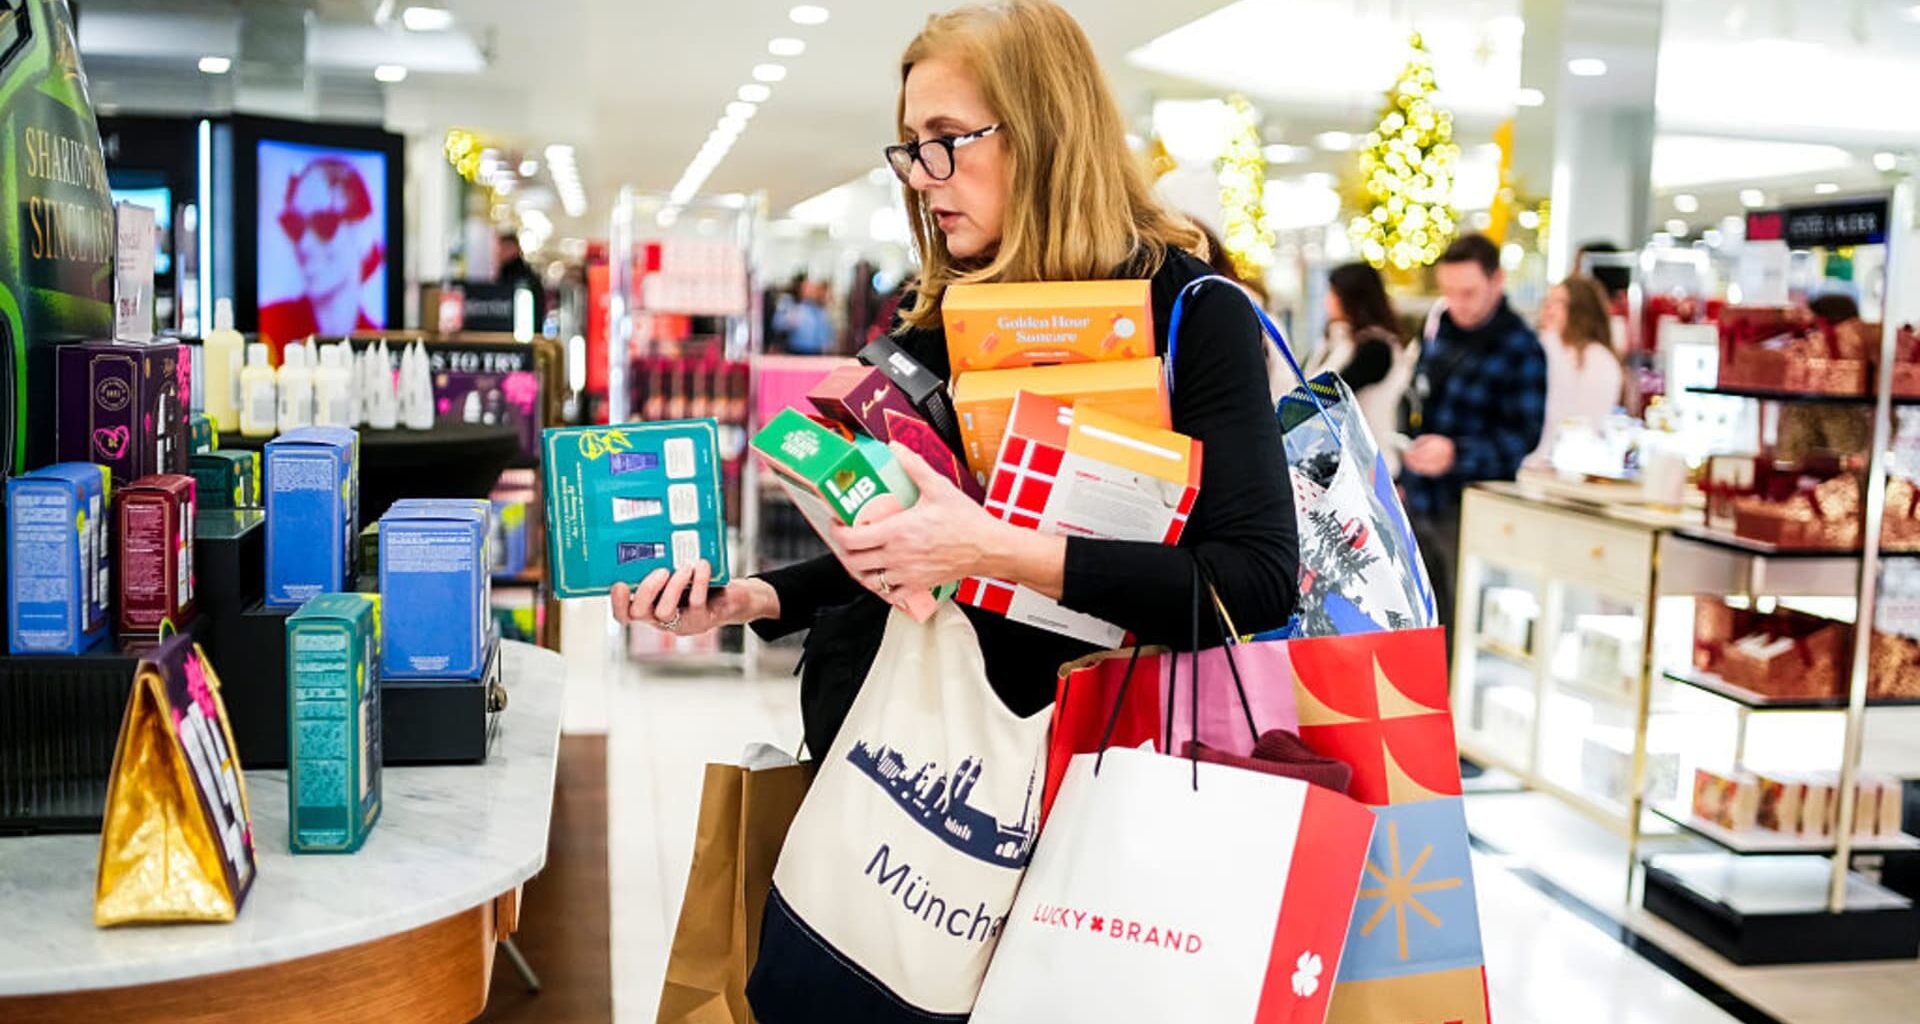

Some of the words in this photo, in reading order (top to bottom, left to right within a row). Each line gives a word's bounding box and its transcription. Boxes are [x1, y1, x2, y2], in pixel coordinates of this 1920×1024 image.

[25, 126, 91, 190] SHARING
[30, 195, 88, 262] SINCE
[998, 315, 1049, 330] Golden
[1051, 314, 1090, 328] Hour
[1016, 331, 1078, 343] Suncare
[840, 476, 877, 514] MB
[1033, 903, 1087, 930] LUCKY
[1109, 918, 1202, 954] BRAND
